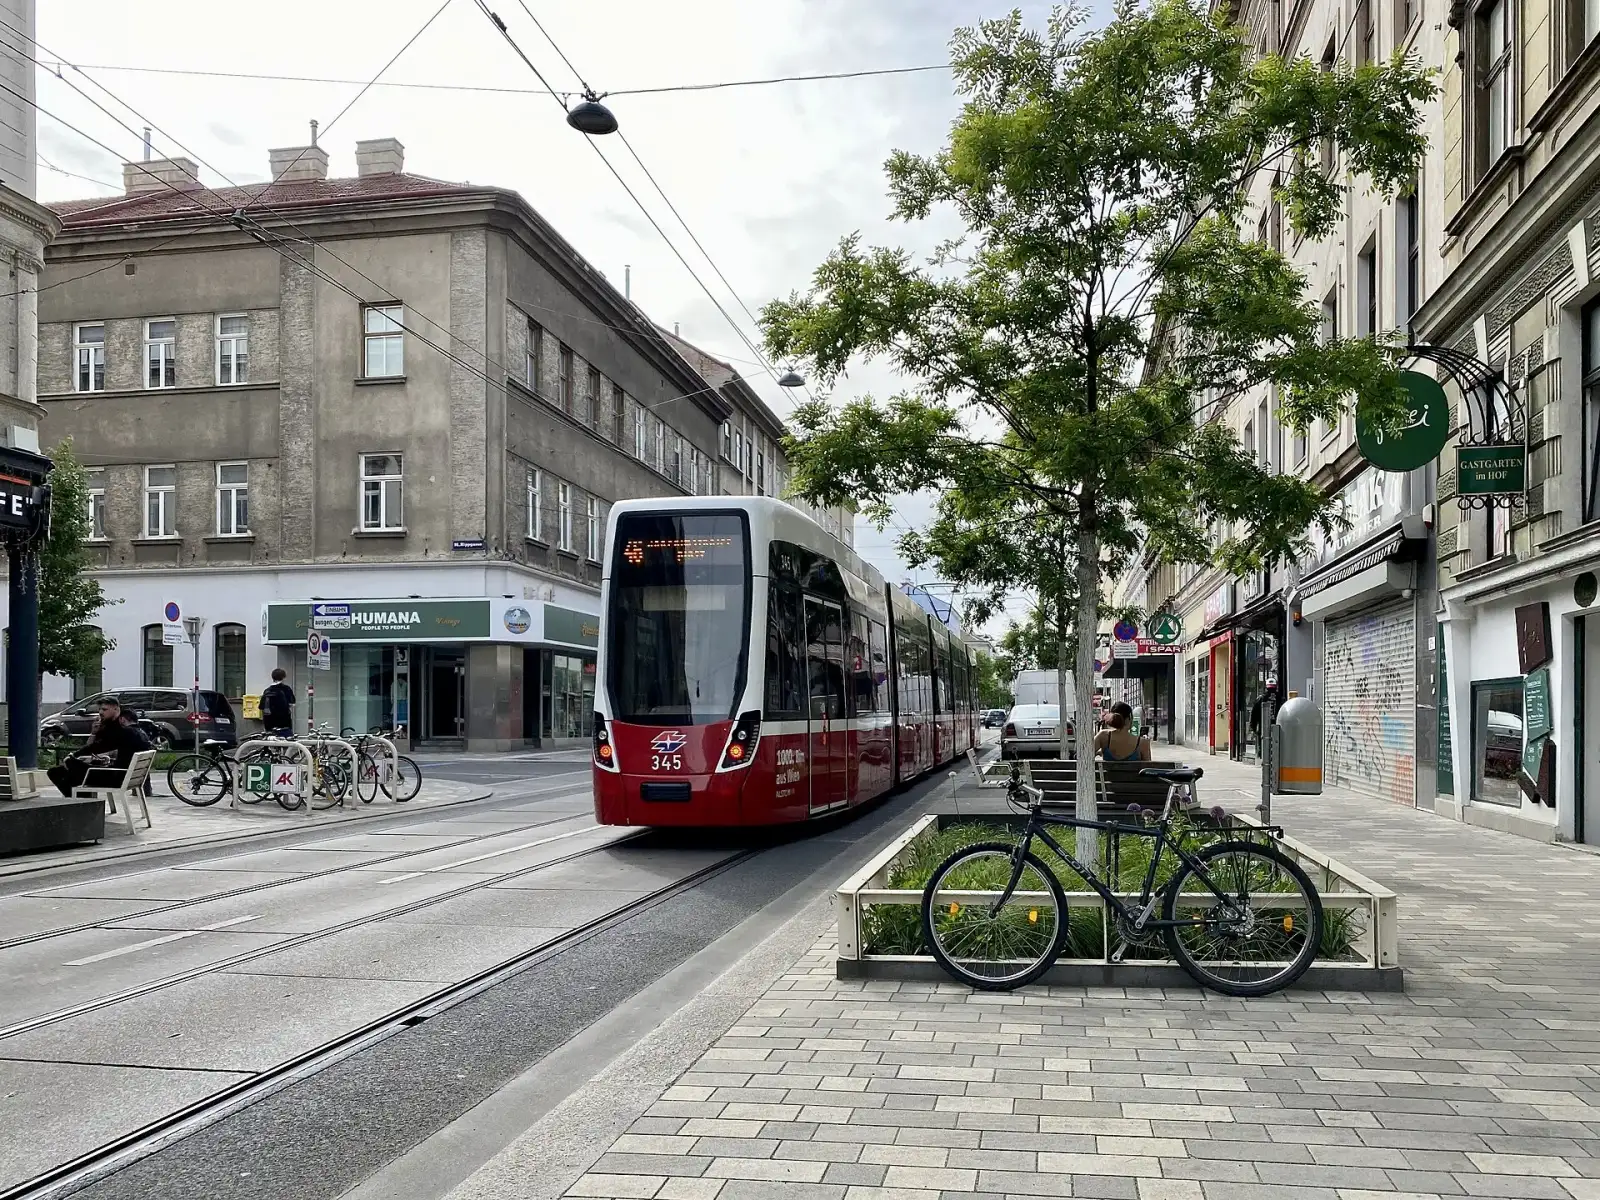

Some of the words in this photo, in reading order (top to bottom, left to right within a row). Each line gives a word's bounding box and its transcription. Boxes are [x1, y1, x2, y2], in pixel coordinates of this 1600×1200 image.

[1460, 458, 1523, 470] GASTGARTEN
[1475, 473, 1486, 481] im
[1488, 471, 1508, 480] HOF
[351, 611, 421, 625] HUMANA
[311, 638, 318, 649] 30
[1149, 645, 1180, 653] SPAR
[309, 656, 320, 666] Zone
[651, 754, 682, 771] 345
[247, 765, 265, 790] P
[275, 772, 294, 786] AK
[1056, 847, 1094, 881] SCOTT
